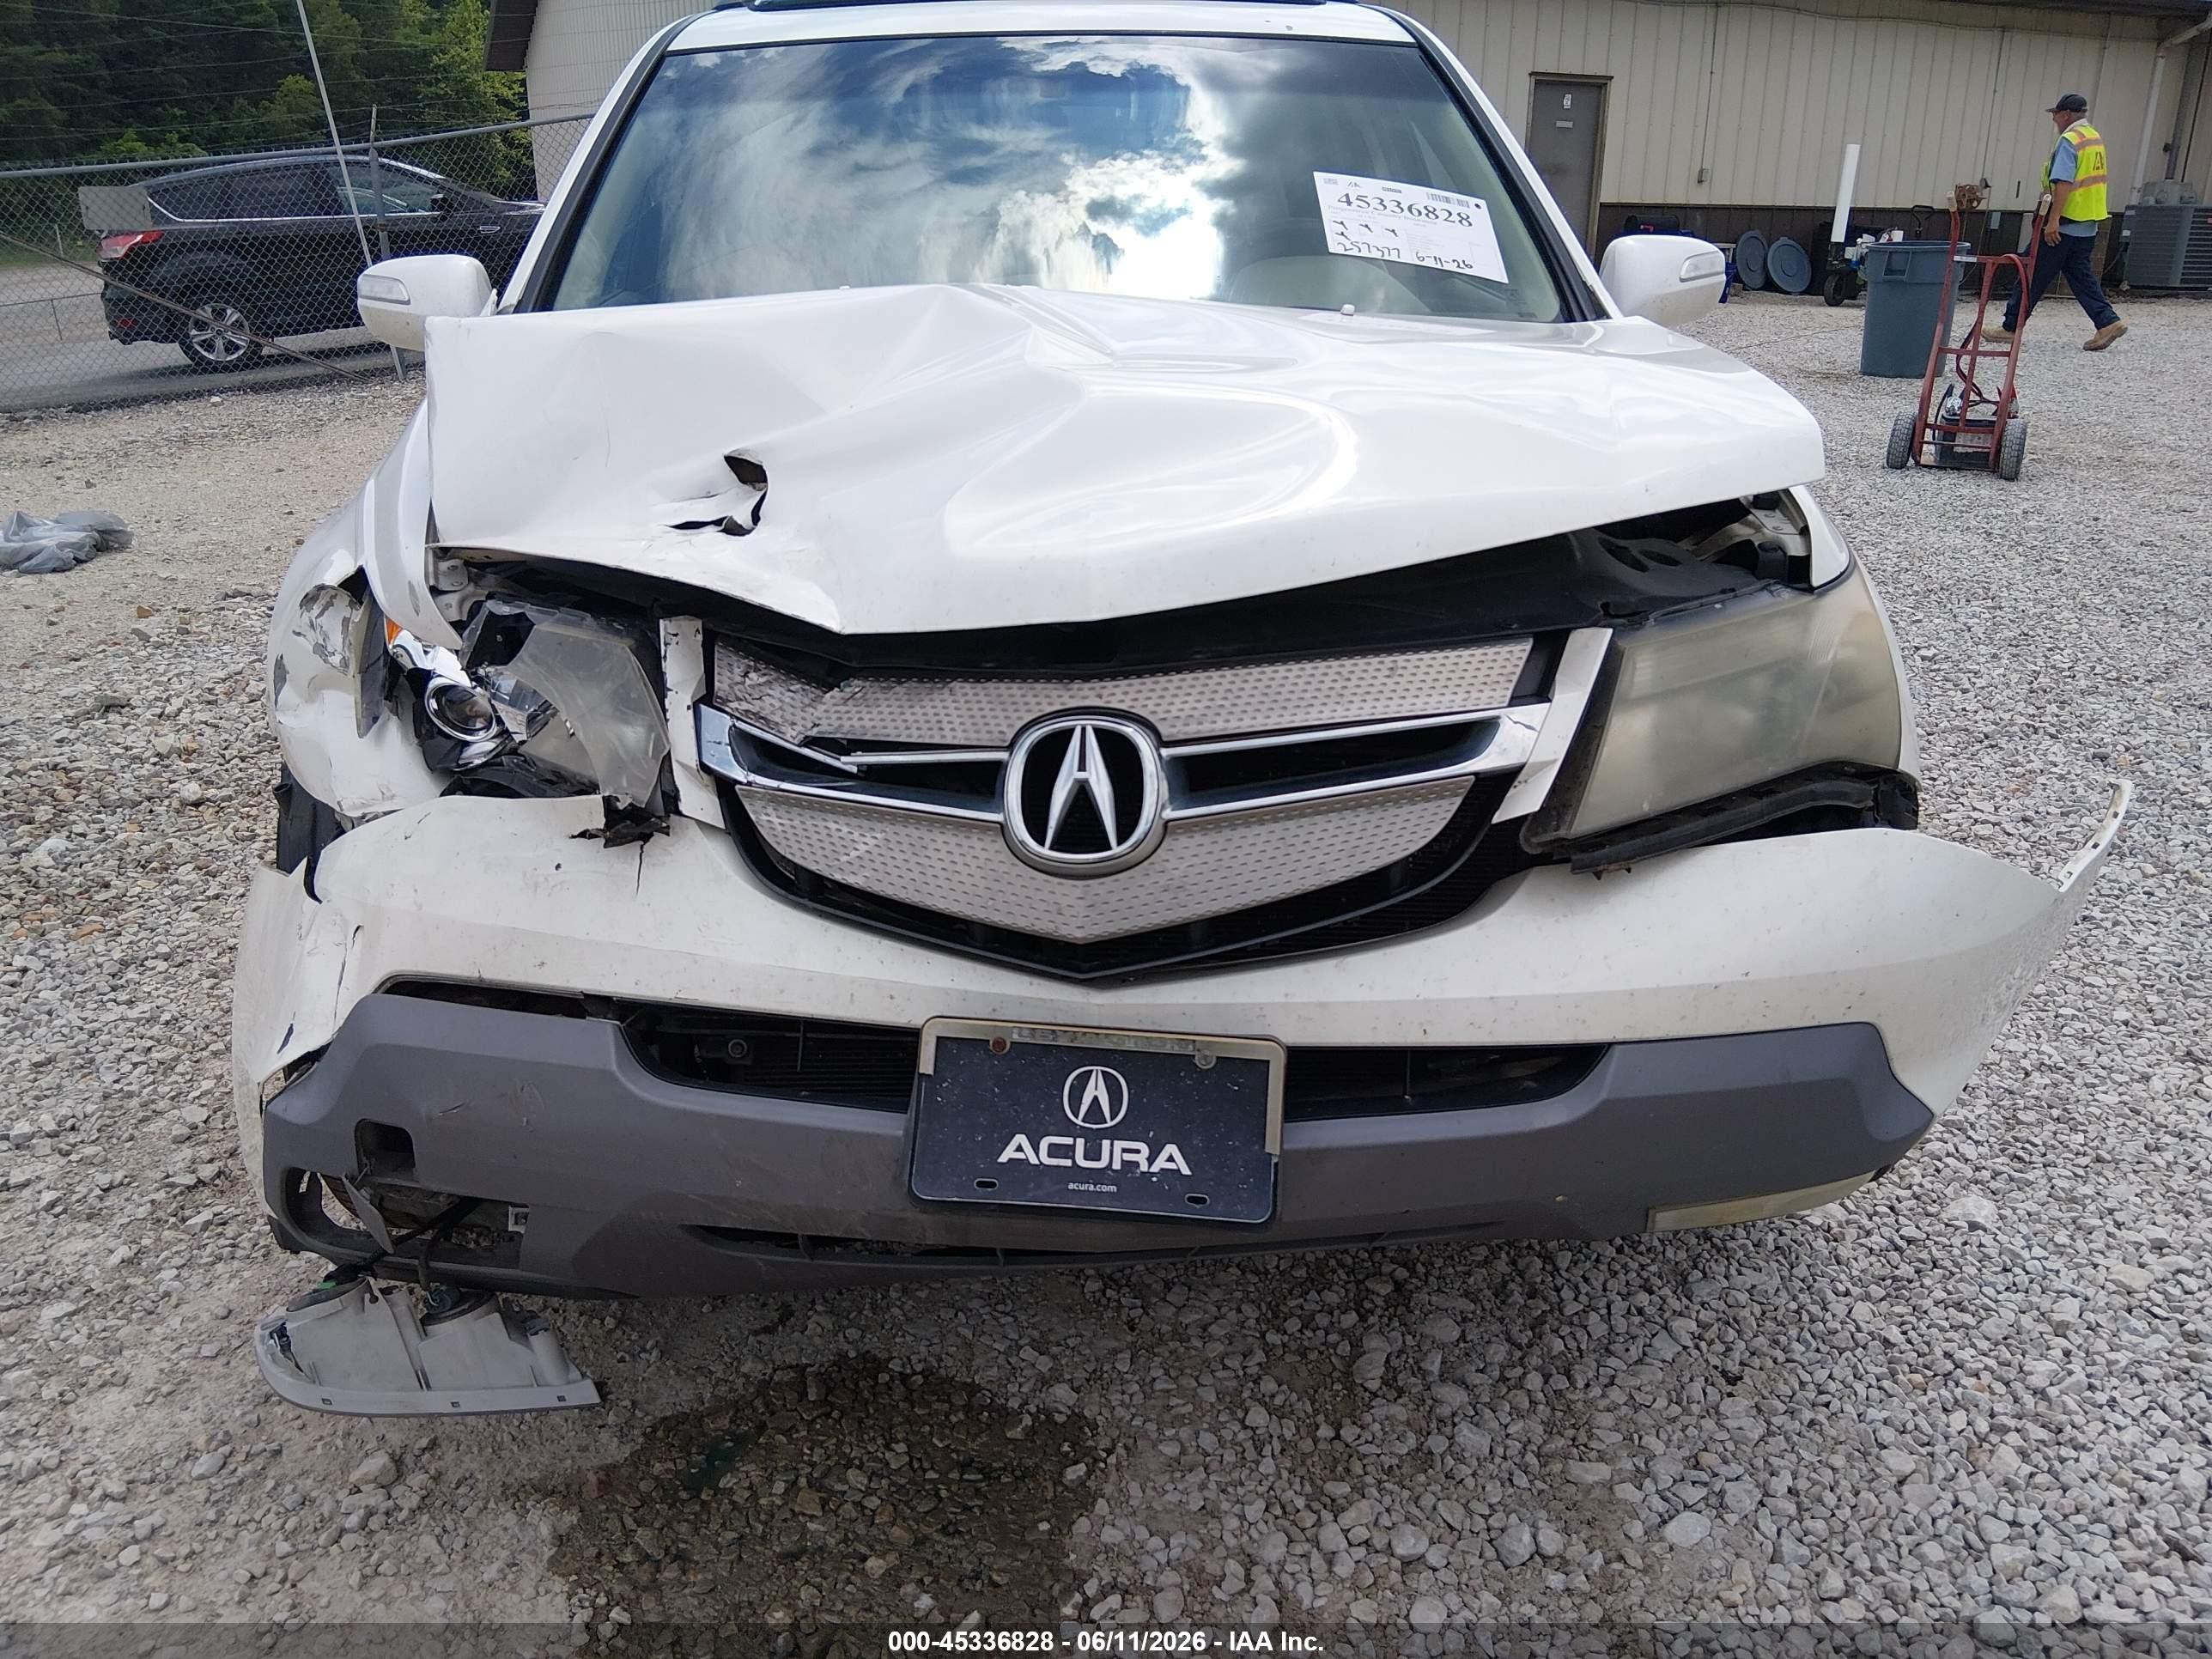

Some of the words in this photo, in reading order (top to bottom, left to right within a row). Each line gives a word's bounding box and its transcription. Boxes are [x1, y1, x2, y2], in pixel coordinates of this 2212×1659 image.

[1337, 192, 1474, 228] 45336828
[997, 1133, 1192, 1176] ACURA
[1067, 1182, 1117, 1193] acura.com
